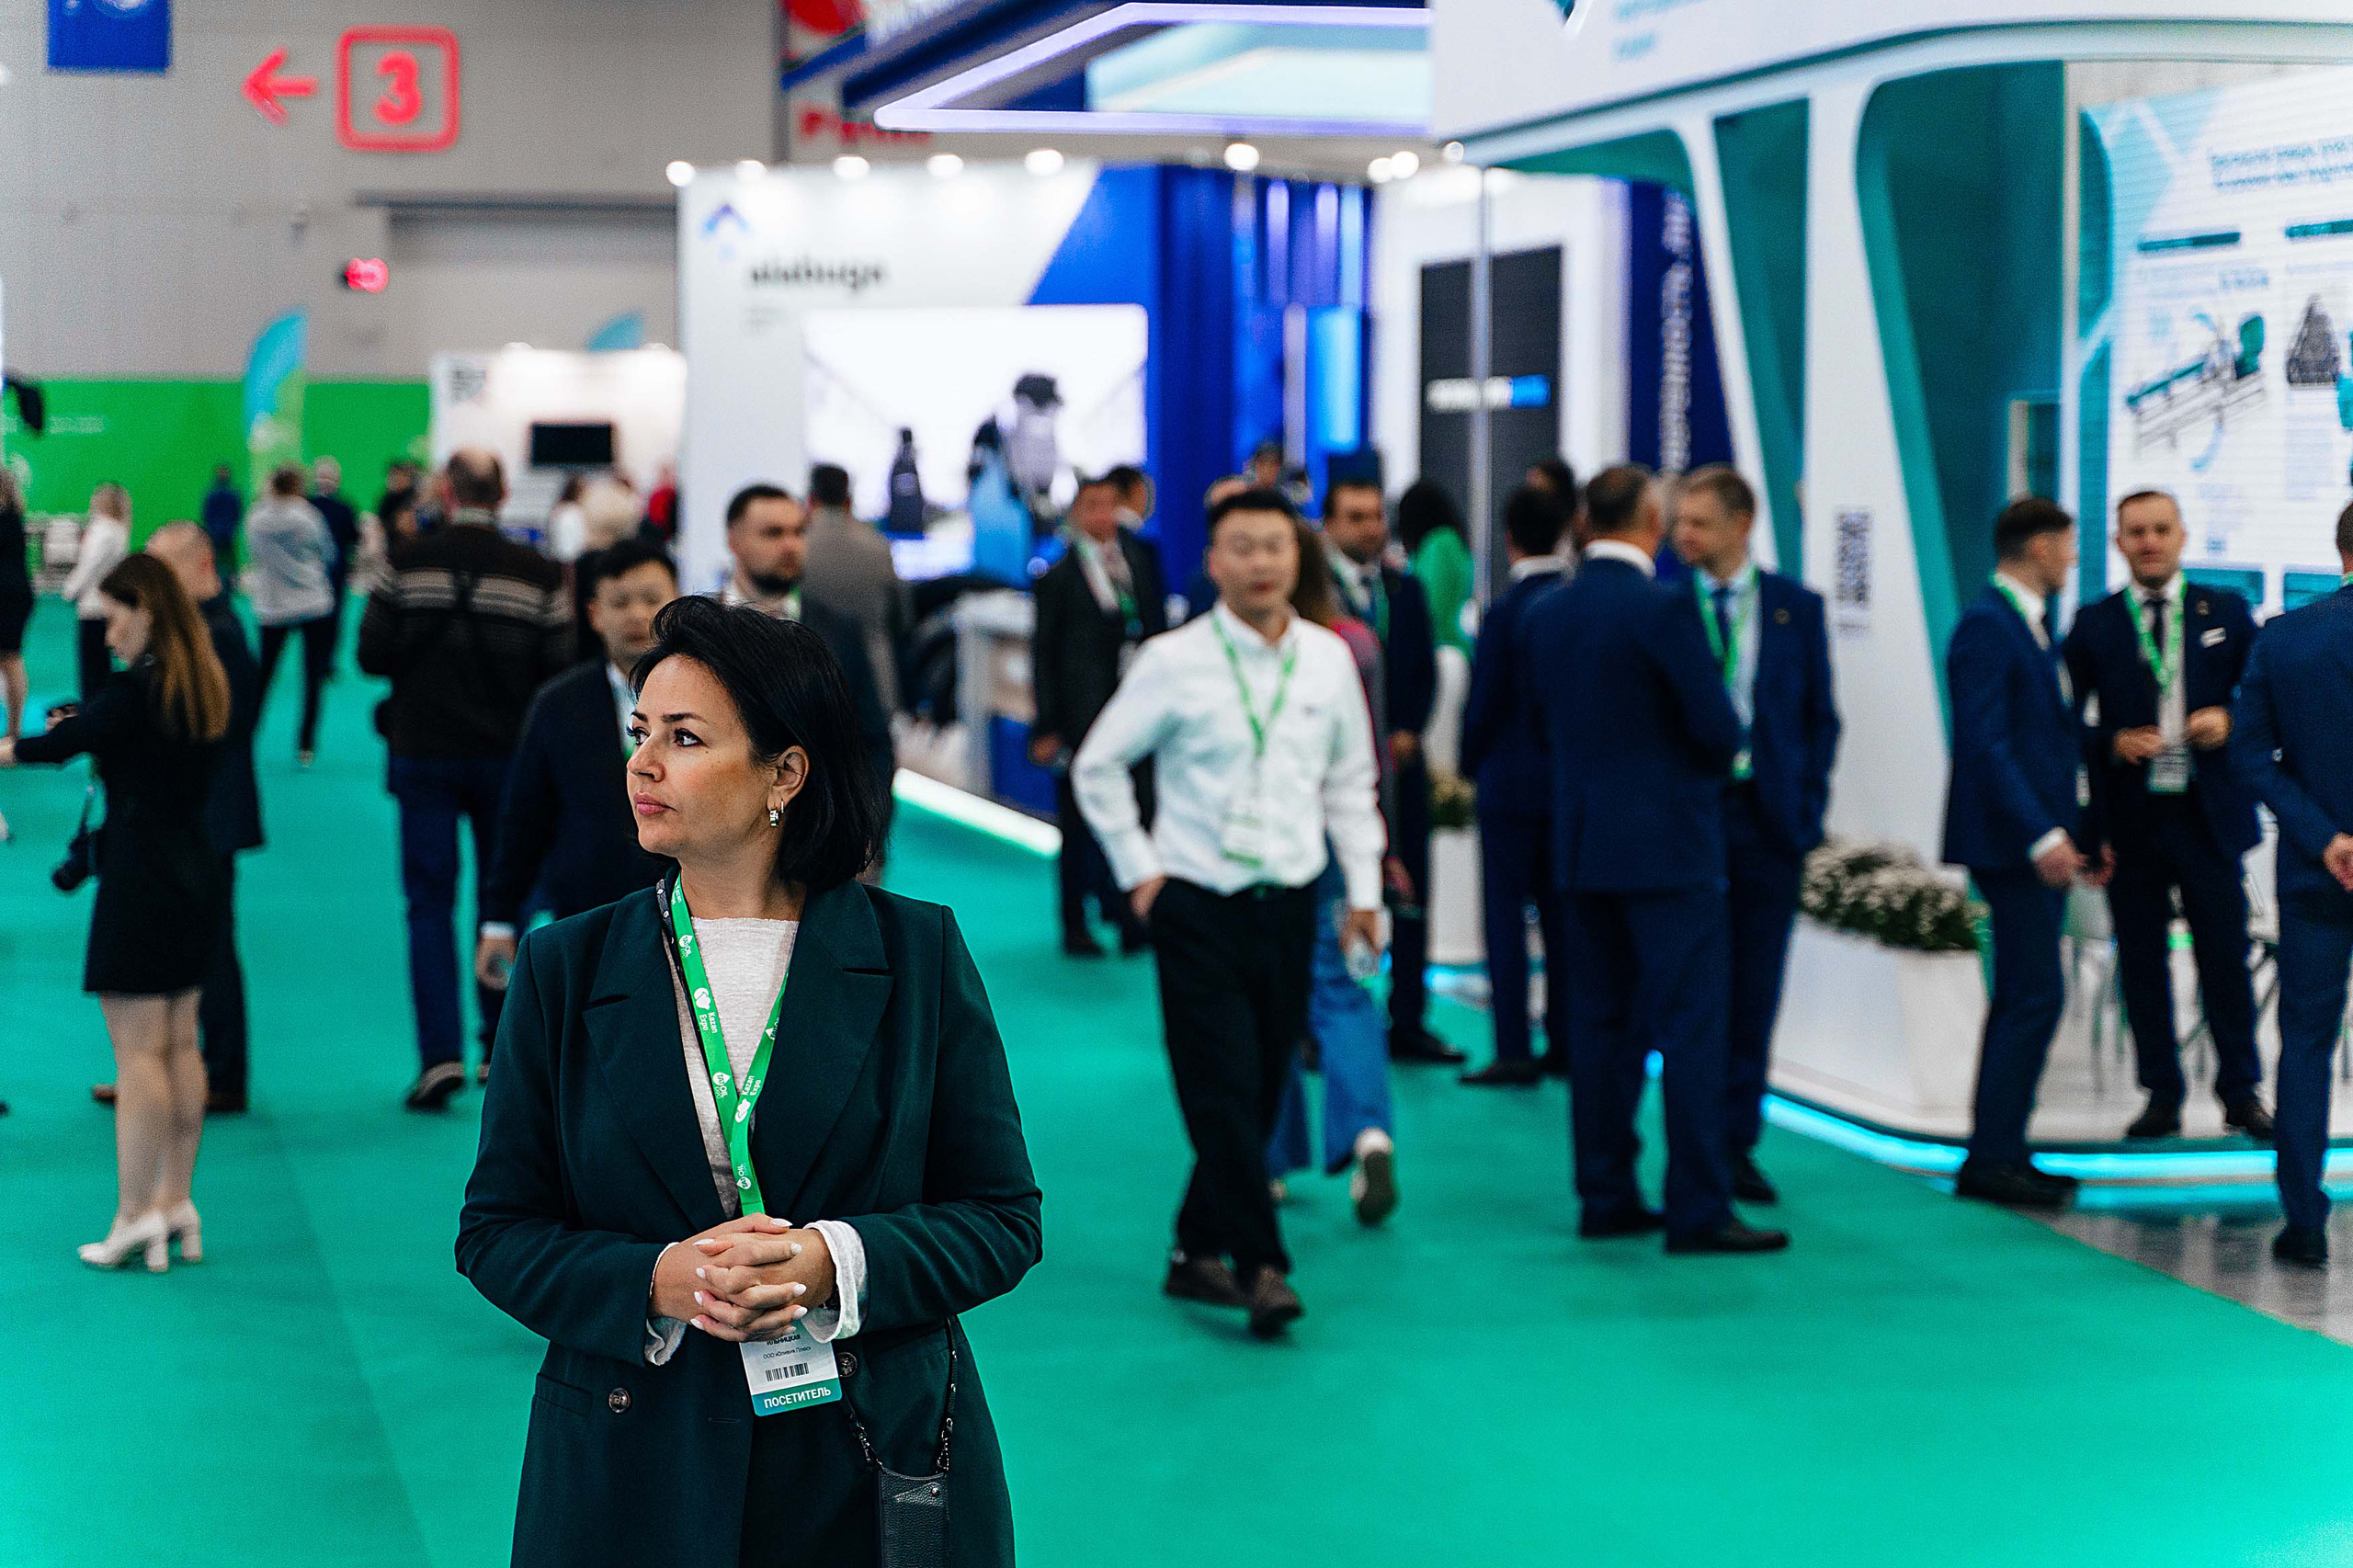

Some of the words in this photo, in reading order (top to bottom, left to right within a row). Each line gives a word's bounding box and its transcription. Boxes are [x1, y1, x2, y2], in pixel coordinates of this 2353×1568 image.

[374, 51, 424, 125] 3
[699, 1014, 709, 1031] Expo
[708, 1012, 718, 1034] Kazan
[741, 1075, 755, 1096] Kazan
[749, 1079, 762, 1096] Expo
[764, 1386, 832, 1409] ПОСЕТИТЕЛЬ
